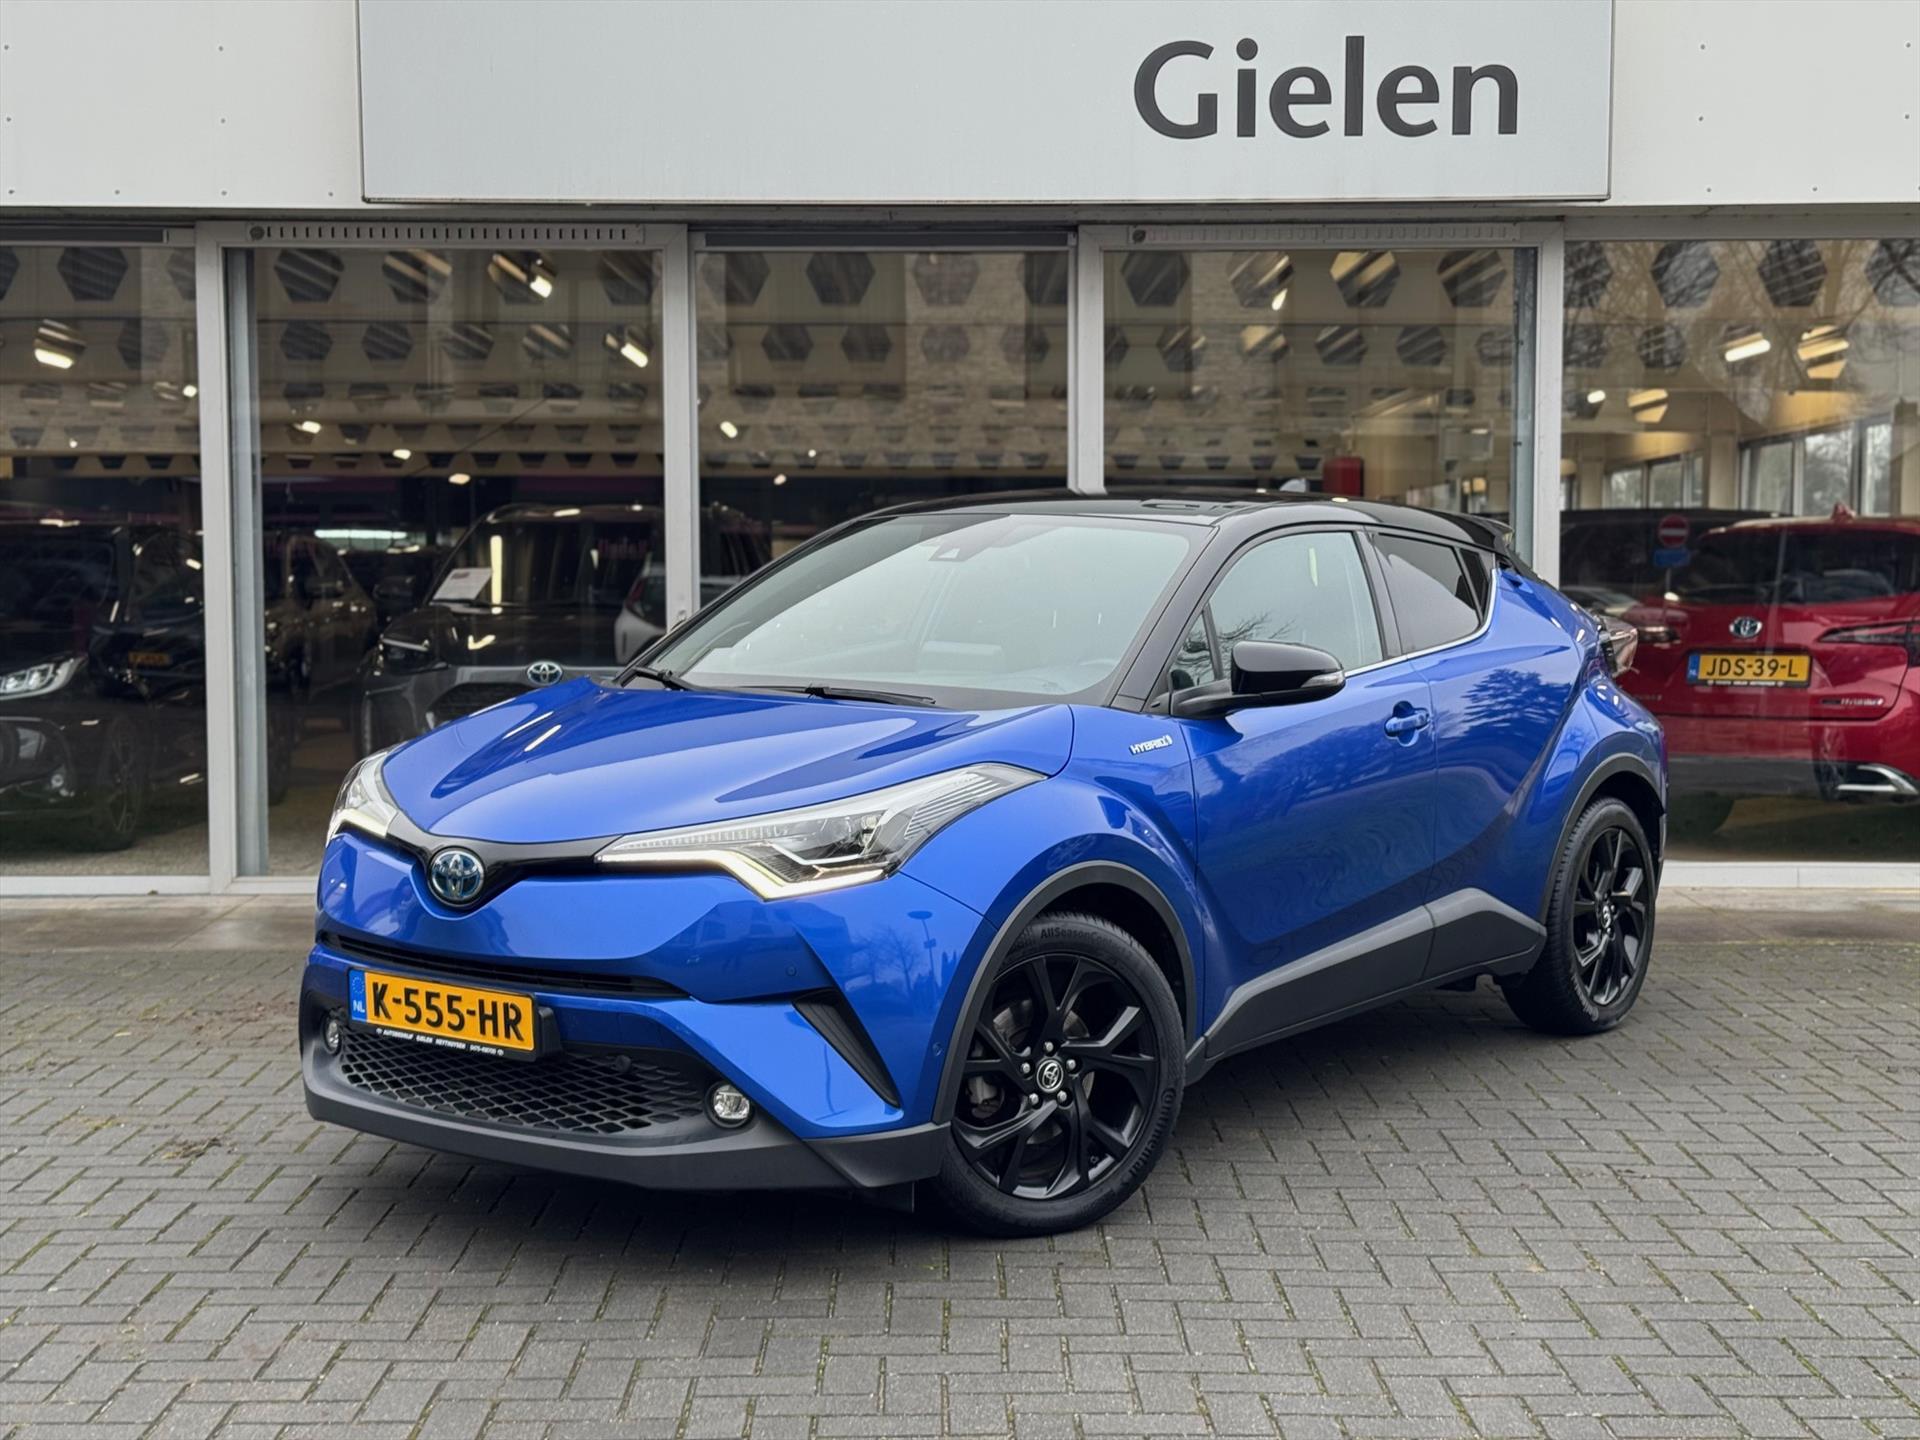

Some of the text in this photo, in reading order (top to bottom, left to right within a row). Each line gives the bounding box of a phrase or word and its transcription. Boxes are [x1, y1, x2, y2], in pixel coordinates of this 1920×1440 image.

[1133, 35, 1519, 139] Gielen
[1706, 658, 1799, 678] JDS-39-L
[1129, 735, 1169, 755] HYBRID
[352, 1001, 366, 1013] NL
[372, 981, 525, 1042] K-555-HR
[1129, 1087, 1176, 1177] Continental
